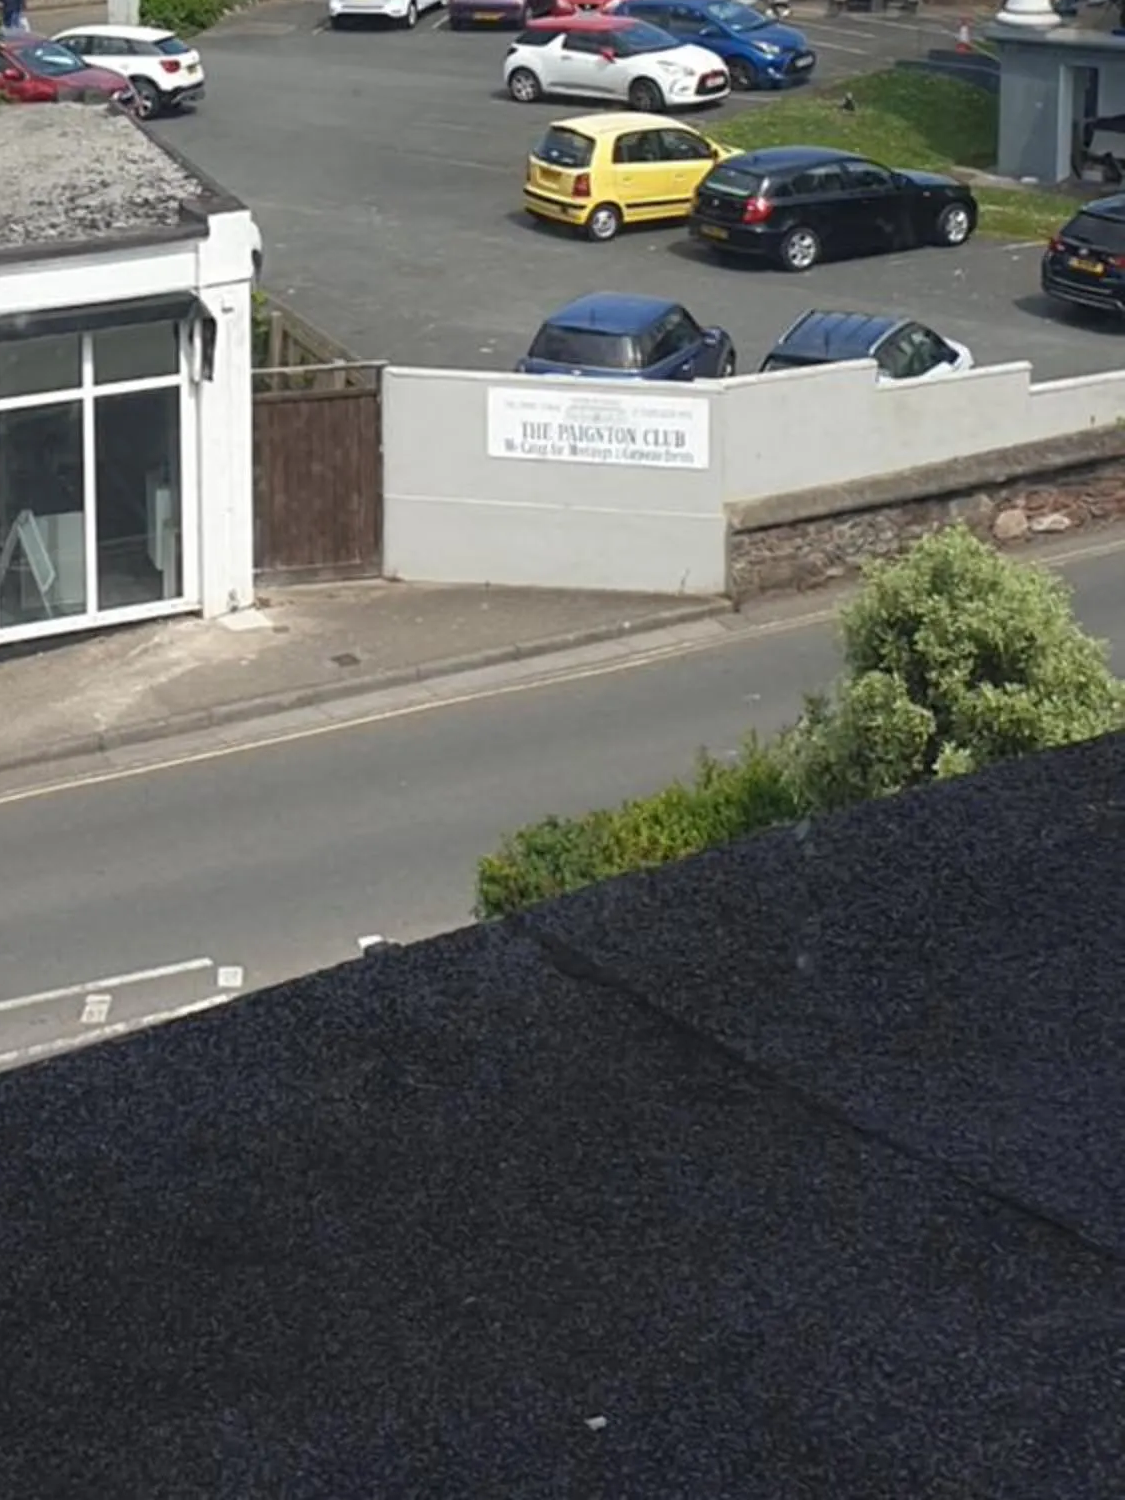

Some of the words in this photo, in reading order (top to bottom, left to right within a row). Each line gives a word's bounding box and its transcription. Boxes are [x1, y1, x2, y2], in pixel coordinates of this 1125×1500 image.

[521, 421, 553, 441] THE
[557, 423, 637, 447] PAIGNTON
[642, 427, 687, 450] CLUB
